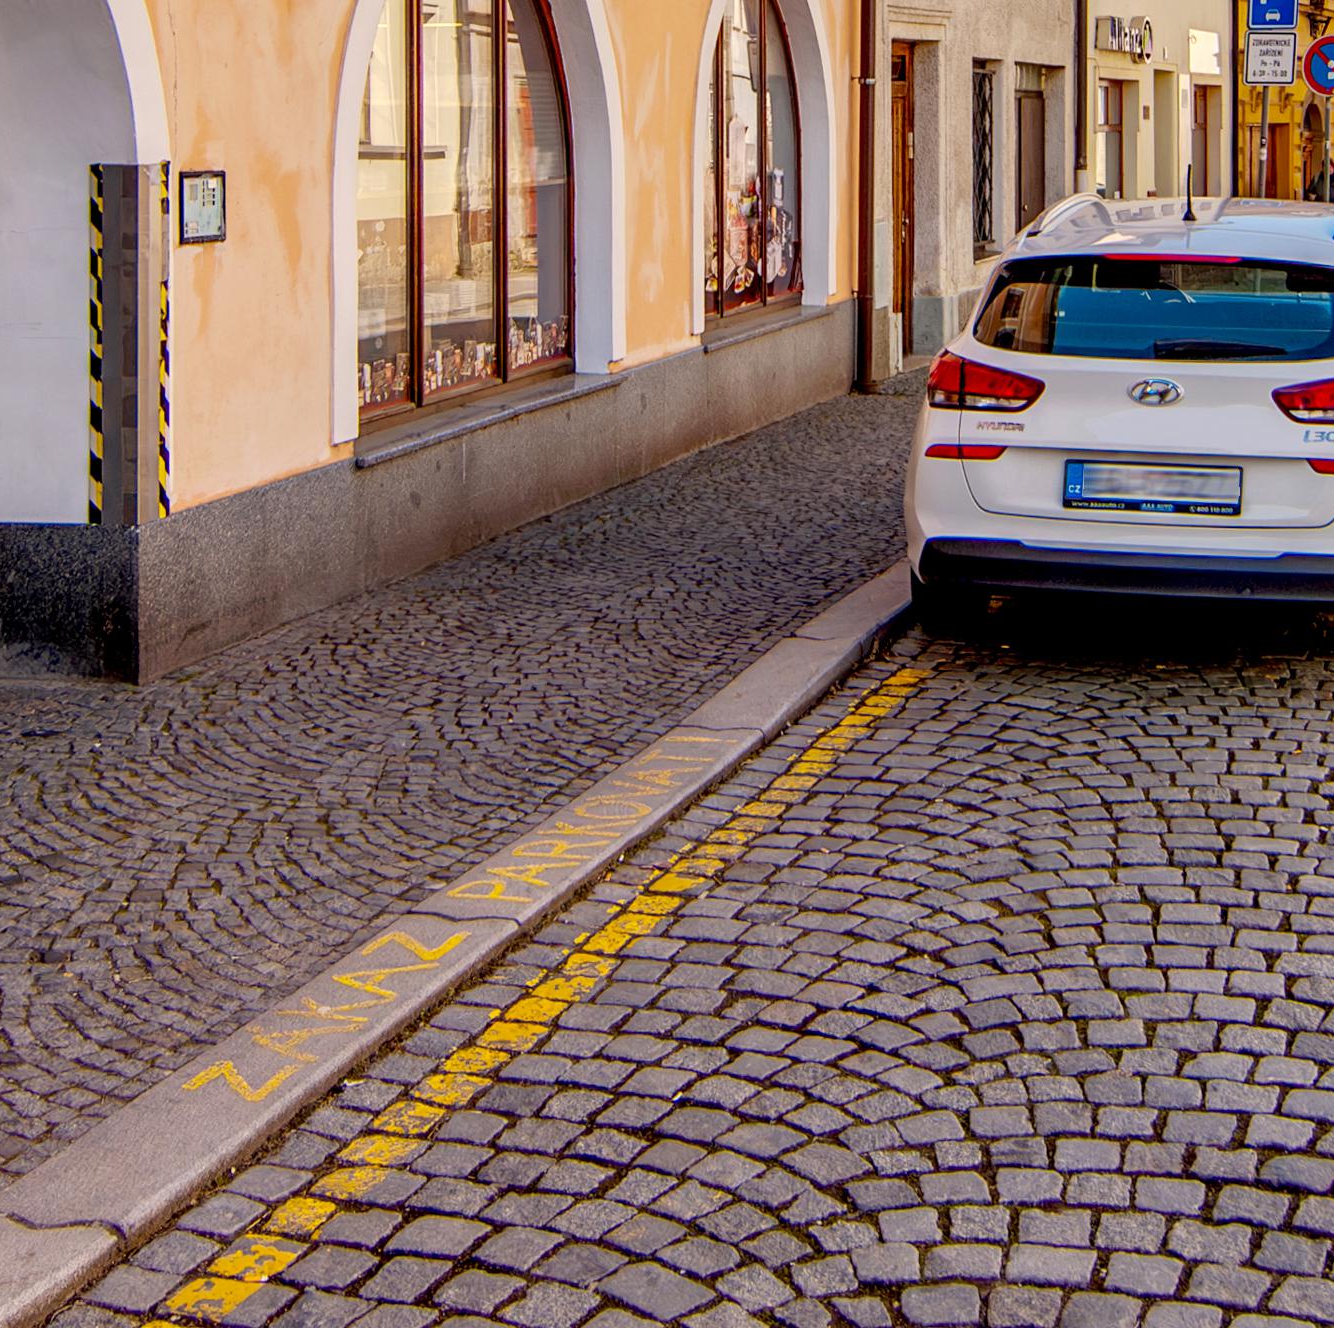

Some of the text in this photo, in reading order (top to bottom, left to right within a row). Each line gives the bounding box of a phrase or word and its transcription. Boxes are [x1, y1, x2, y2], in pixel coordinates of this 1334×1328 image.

[976, 421, 1025, 432] HYUNDAI
[1068, 484, 1081, 494] CZ
[181, 929, 473, 1103] ZAKAZ
